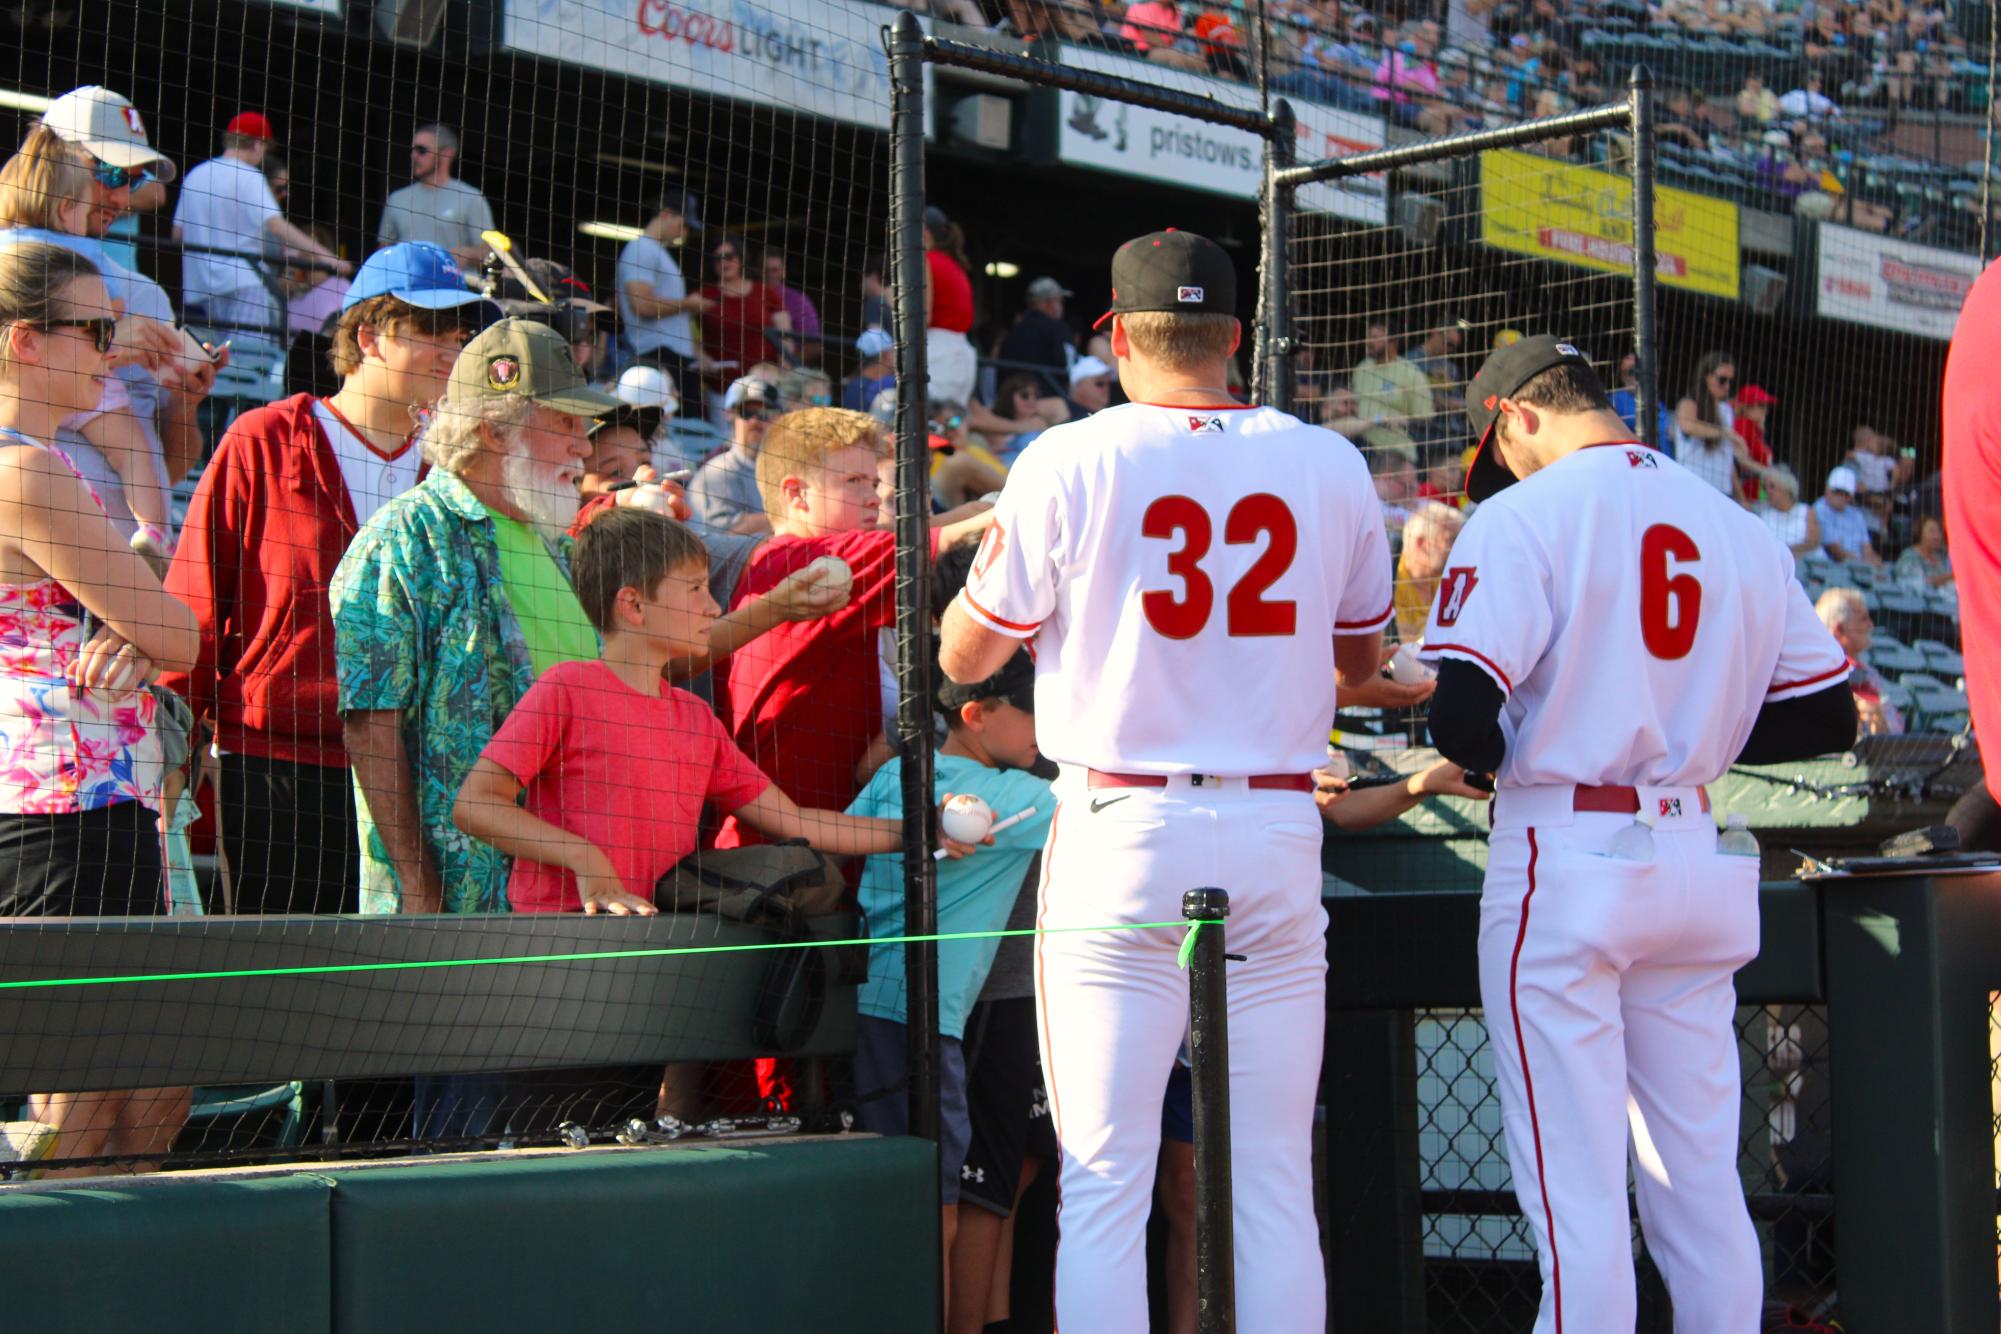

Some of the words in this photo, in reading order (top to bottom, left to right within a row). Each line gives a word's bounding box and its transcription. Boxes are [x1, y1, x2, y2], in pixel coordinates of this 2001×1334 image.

[637, 0, 734, 53] Coors
[740, 25, 821, 71] LIGHT
[1151, 123, 1264, 172] pristows.
[1142, 492, 1297, 640] 32
[1640, 523, 1702, 661] 6
